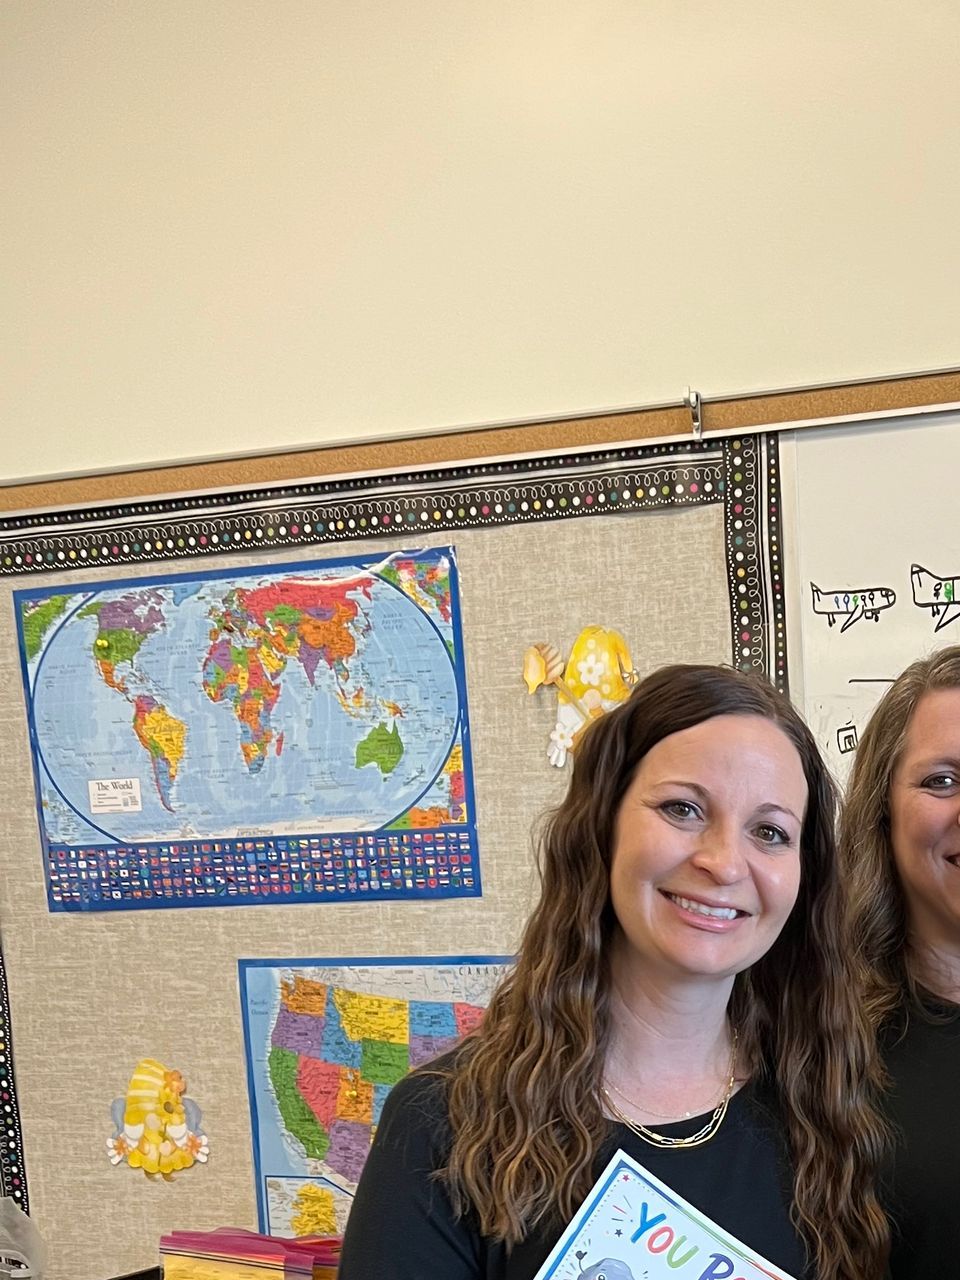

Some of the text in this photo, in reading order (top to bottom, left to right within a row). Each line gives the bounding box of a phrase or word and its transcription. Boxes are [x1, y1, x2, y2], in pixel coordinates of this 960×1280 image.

[111, 780, 133, 790] World
[458, 966, 507, 976] CANAD
[630, 1202, 699, 1269] YOU
